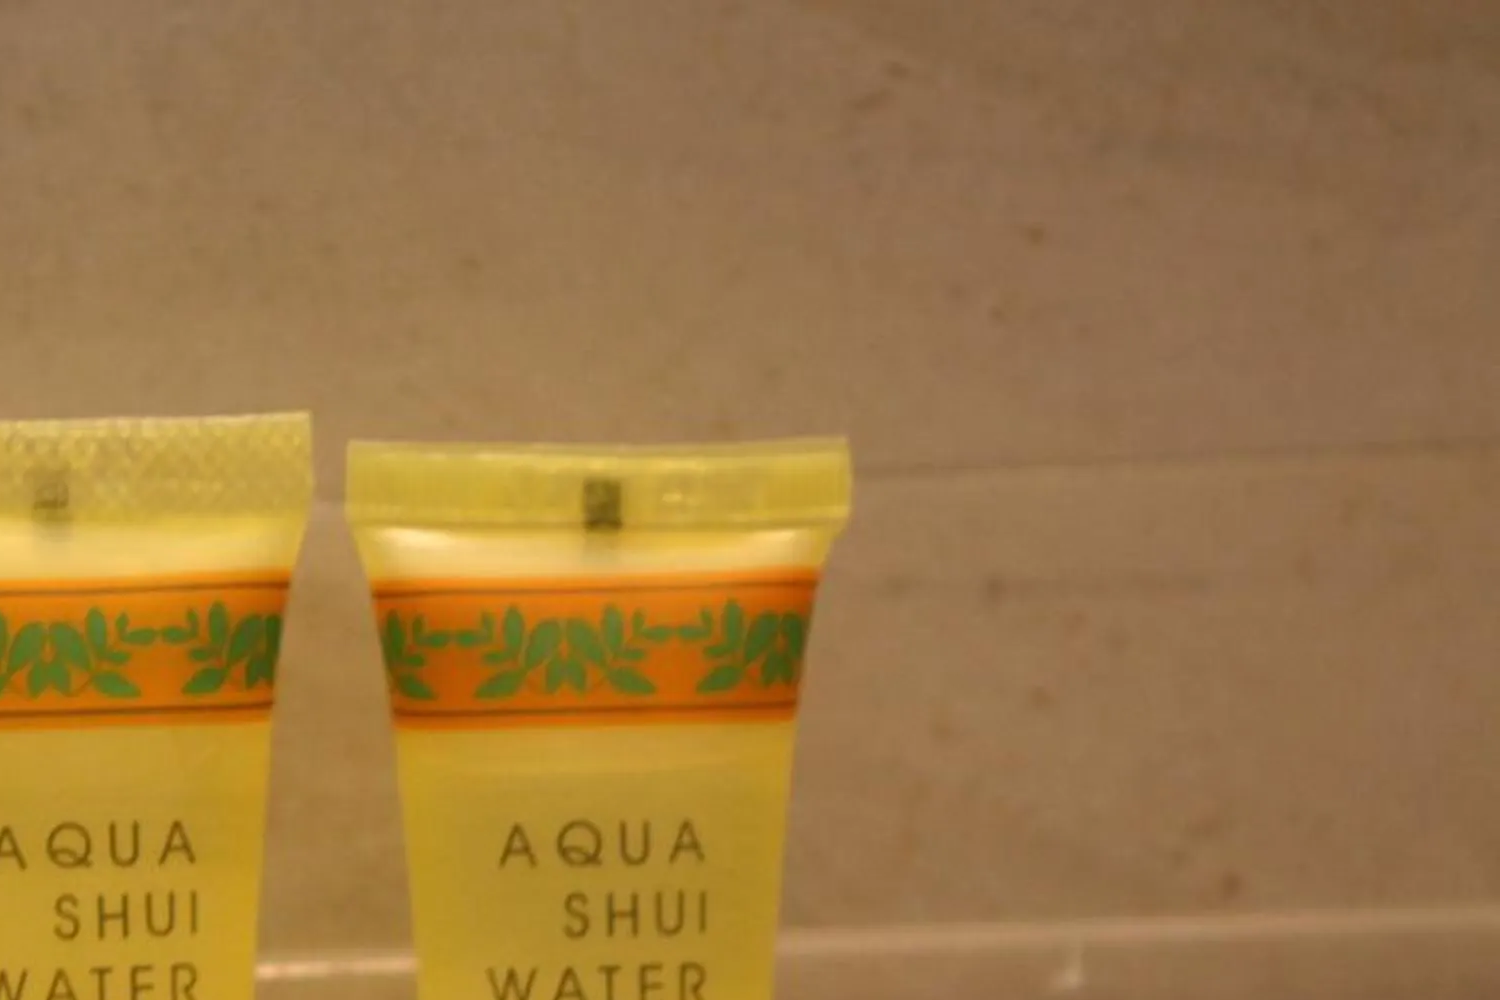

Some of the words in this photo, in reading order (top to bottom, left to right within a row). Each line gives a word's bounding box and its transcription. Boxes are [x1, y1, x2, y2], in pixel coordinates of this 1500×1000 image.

[498, 818, 706, 868] AQUA
[53, 890, 198, 941] SHUI
[563, 888, 708, 939] SHUI
